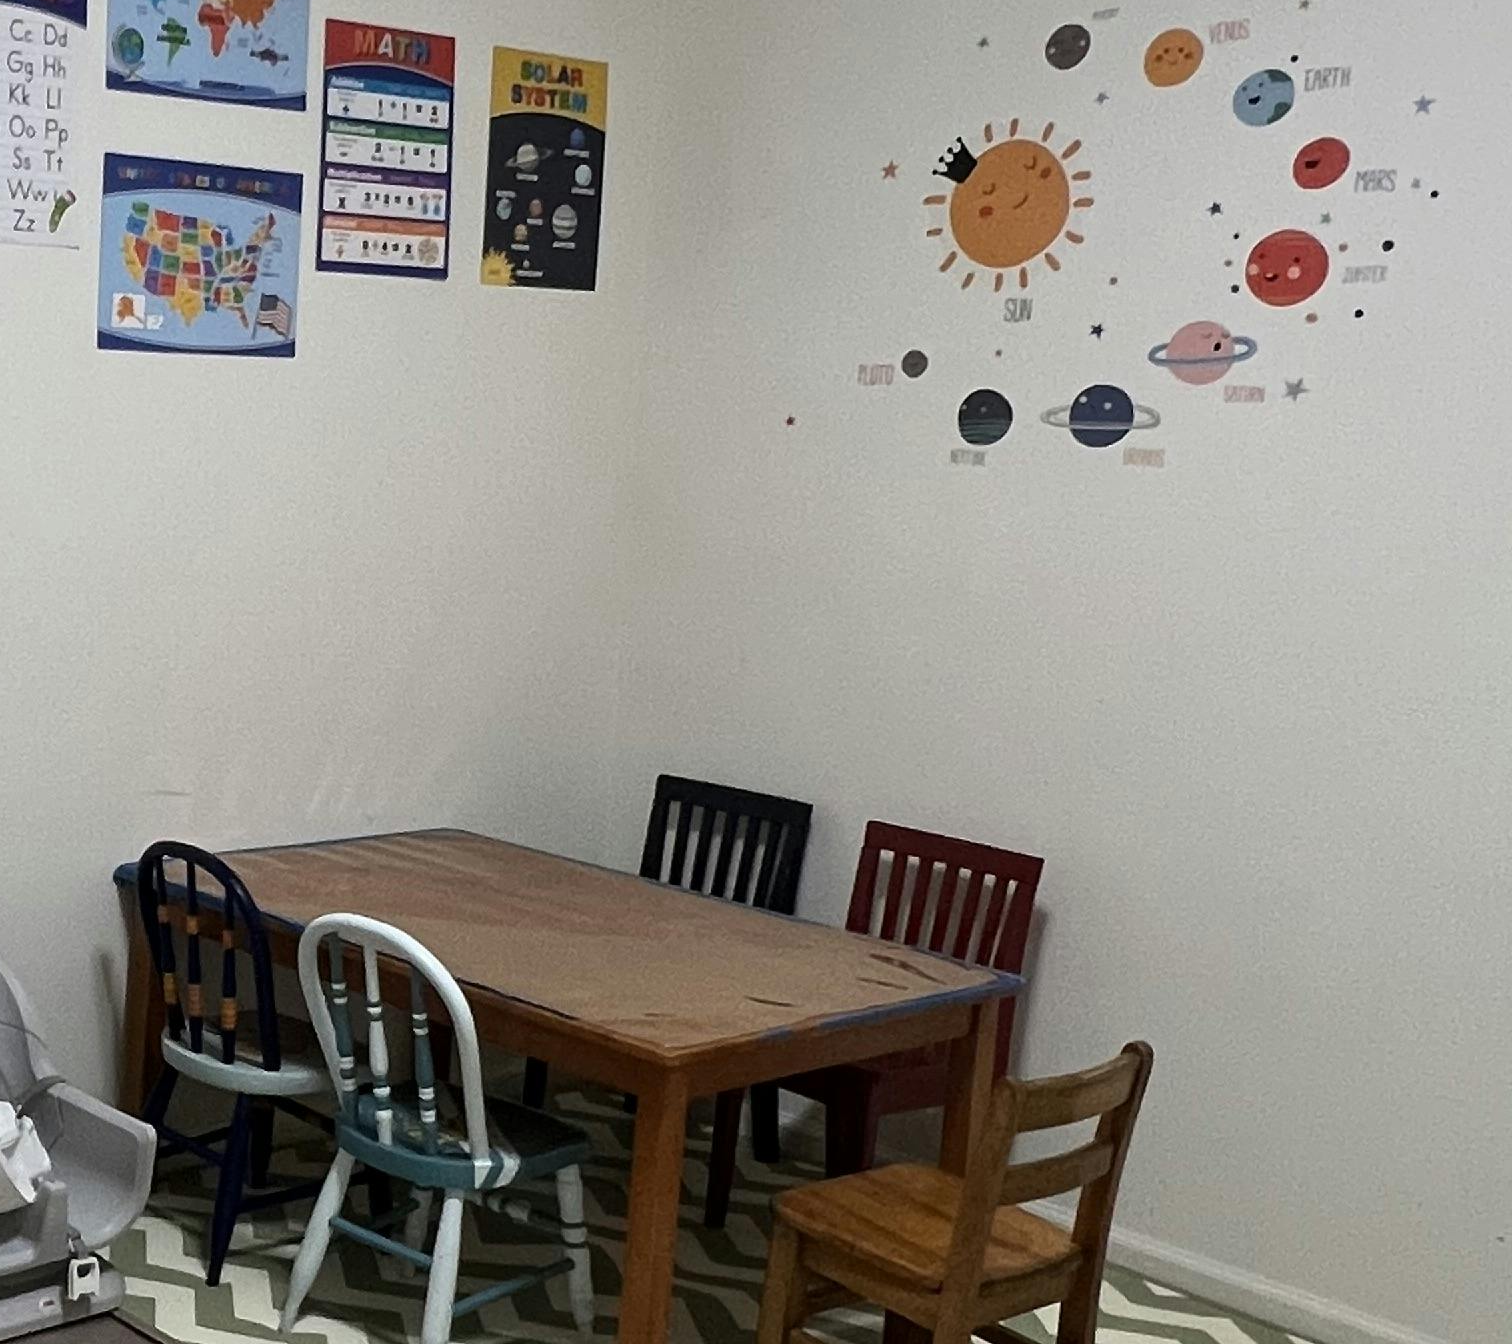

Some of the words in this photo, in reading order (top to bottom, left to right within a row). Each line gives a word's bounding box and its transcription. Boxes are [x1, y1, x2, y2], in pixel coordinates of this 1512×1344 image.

[9, 18, 34, 43] Cc
[43, 23, 68, 48] Dd
[353, 29, 429, 64] MATH
[7, 50, 34, 83] Gg
[42, 55, 66, 79] Hh
[520, 60, 584, 88] SOLAR
[1304, 66, 1352, 92] EARTH
[8, 83, 31, 106] Kk
[511, 84, 588, 114] SYSTEM
[9, 114, 36, 138] Oo
[44, 118, 69, 149] Pp
[12, 146, 31, 170] Ss
[43, 149, 63, 172] Tt
[7, 178, 48, 201] Ww
[1354, 168, 1398, 193] MARS
[13, 208, 36, 232] Zz
[1003, 298, 1034, 323] SUN
